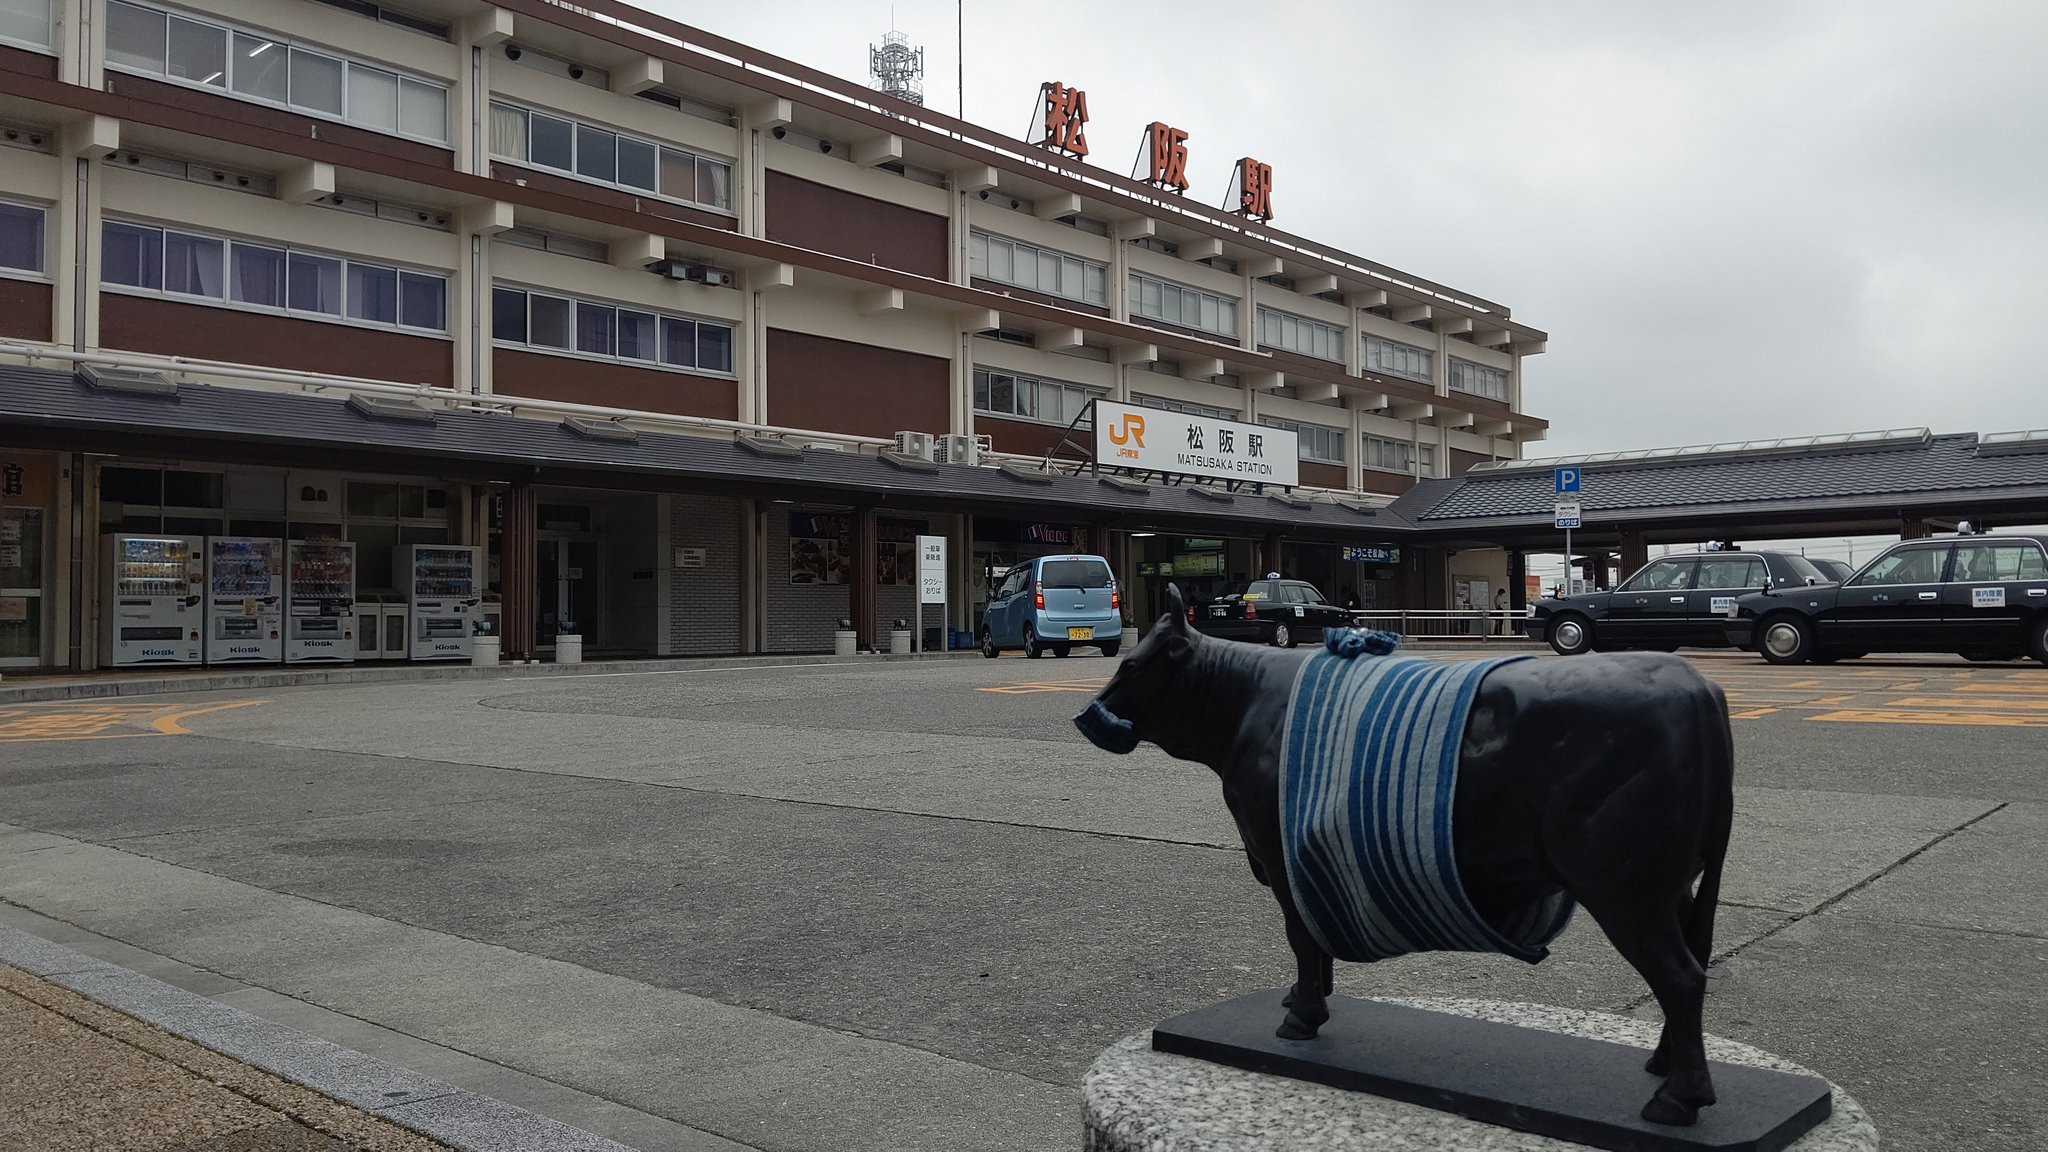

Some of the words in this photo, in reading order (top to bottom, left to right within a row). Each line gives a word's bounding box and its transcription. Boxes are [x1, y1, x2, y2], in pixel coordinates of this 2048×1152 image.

[1046, 81, 1274, 220] 松阪駅
[1109, 413, 1146, 448] JR
[1187, 424, 1263, 458] 松阪駅
[1177, 453, 1234, 471] MATSUSAKA
[1236, 460, 1273, 475] STATION
[1561, 469, 1576, 490] P
[923, 578, 943, 586] タクシー
[925, 587, 941, 595] おりば
[142, 648, 175, 656] Kiosk
[230, 646, 261, 654] Kiosk
[435, 643, 460, 651] Kiosk
